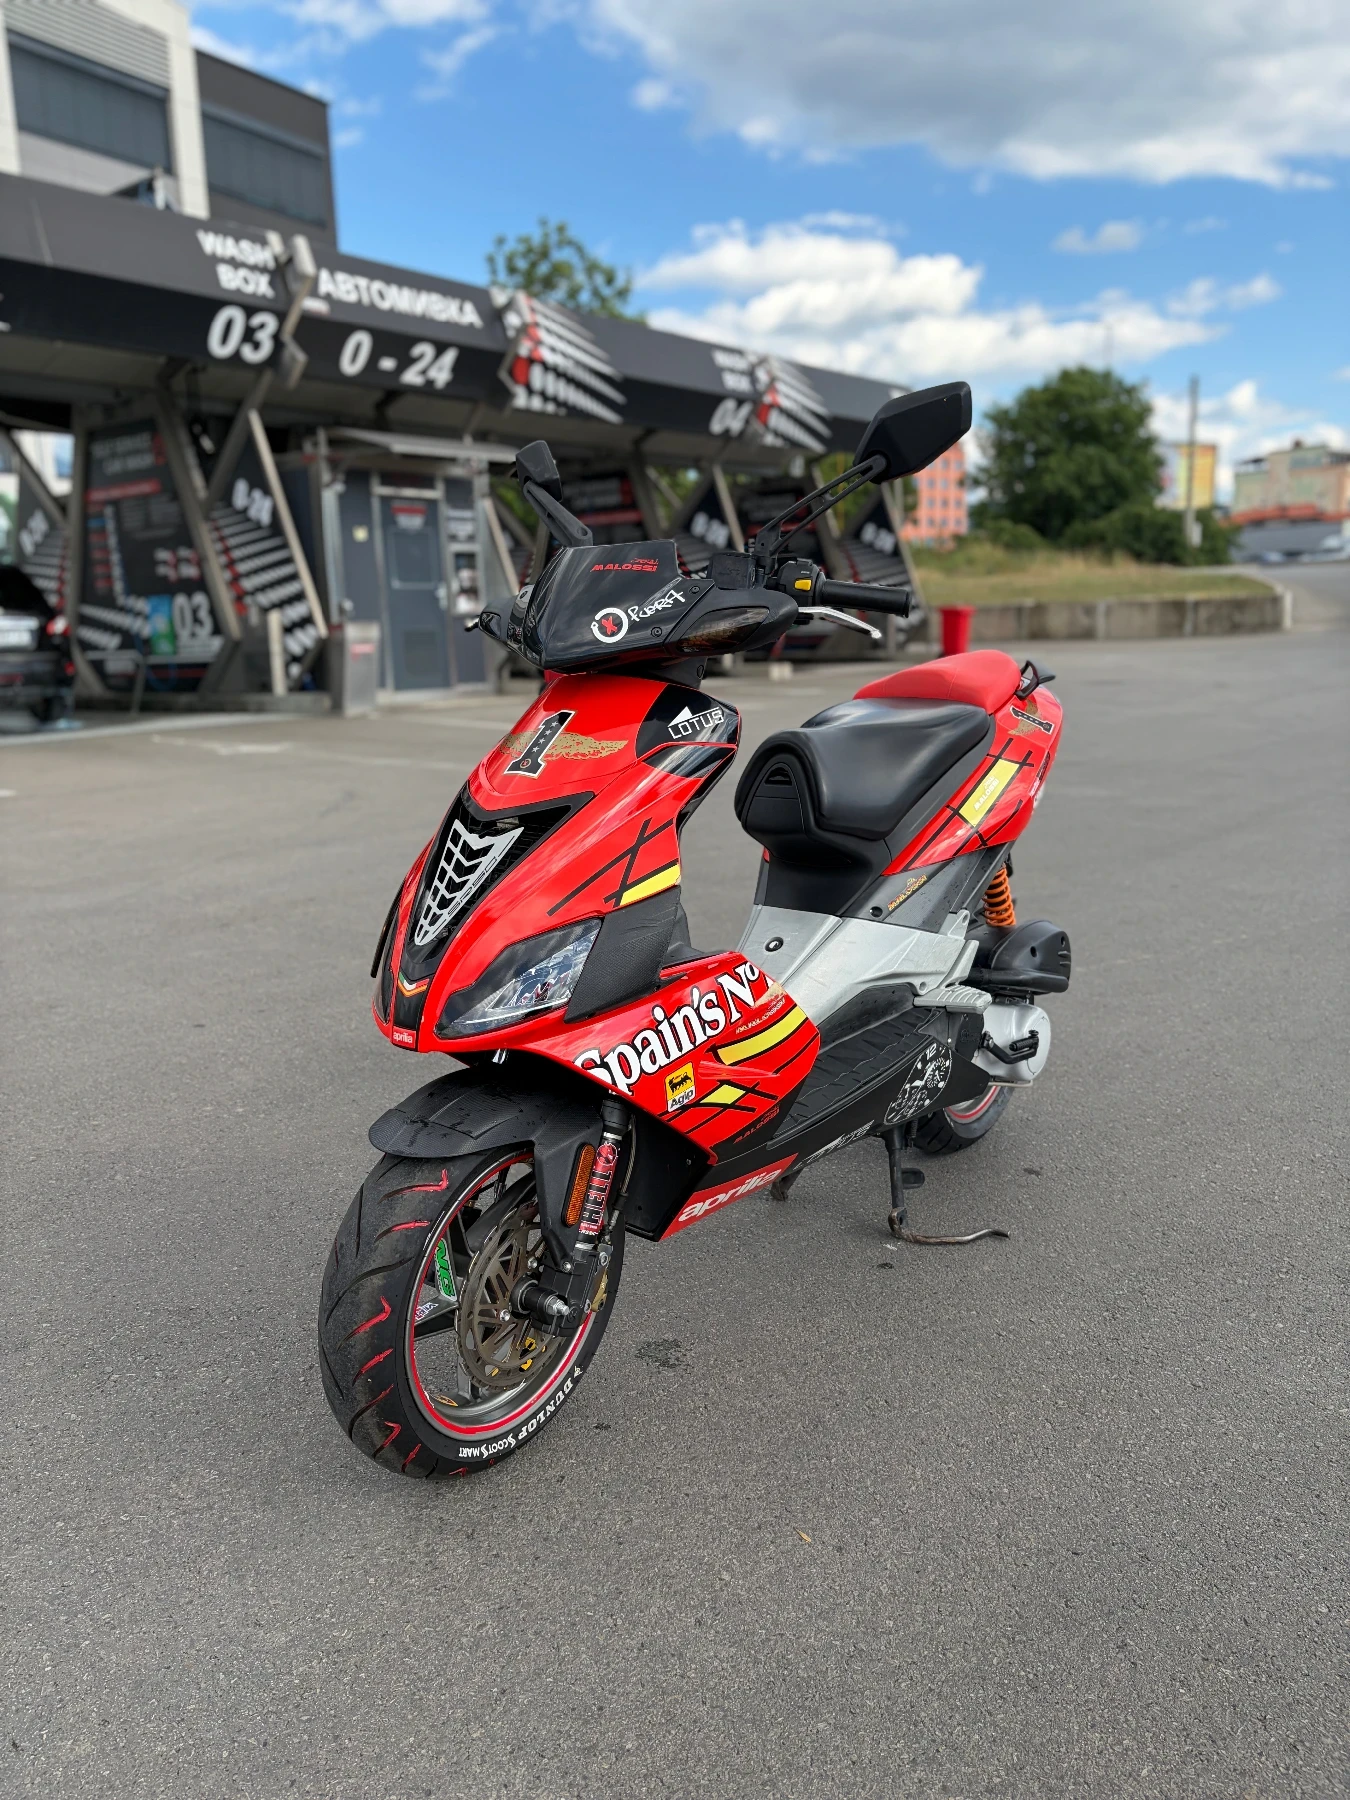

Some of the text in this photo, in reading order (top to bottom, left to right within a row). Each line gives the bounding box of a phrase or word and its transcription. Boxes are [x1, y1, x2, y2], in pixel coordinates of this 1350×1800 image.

[196, 229, 275, 270] WASH
[216, 263, 275, 299] BOX
[318, 268, 484, 328] АВТОМИВКА
[207, 305, 279, 364] 03
[400, 341, 459, 389] 24
[590, 563, 658, 573] MALOSSI
[172, 591, 214, 638] 03
[668, 709, 725, 740] LOTUS
[392, 1032, 413, 1045] aprilia
[574, 986, 726, 1096] Spain's
[669, 1088, 694, 1109] Agip
[678, 1168, 783, 1222] aprilia
[518, 1377, 574, 1441] DUNLOP
